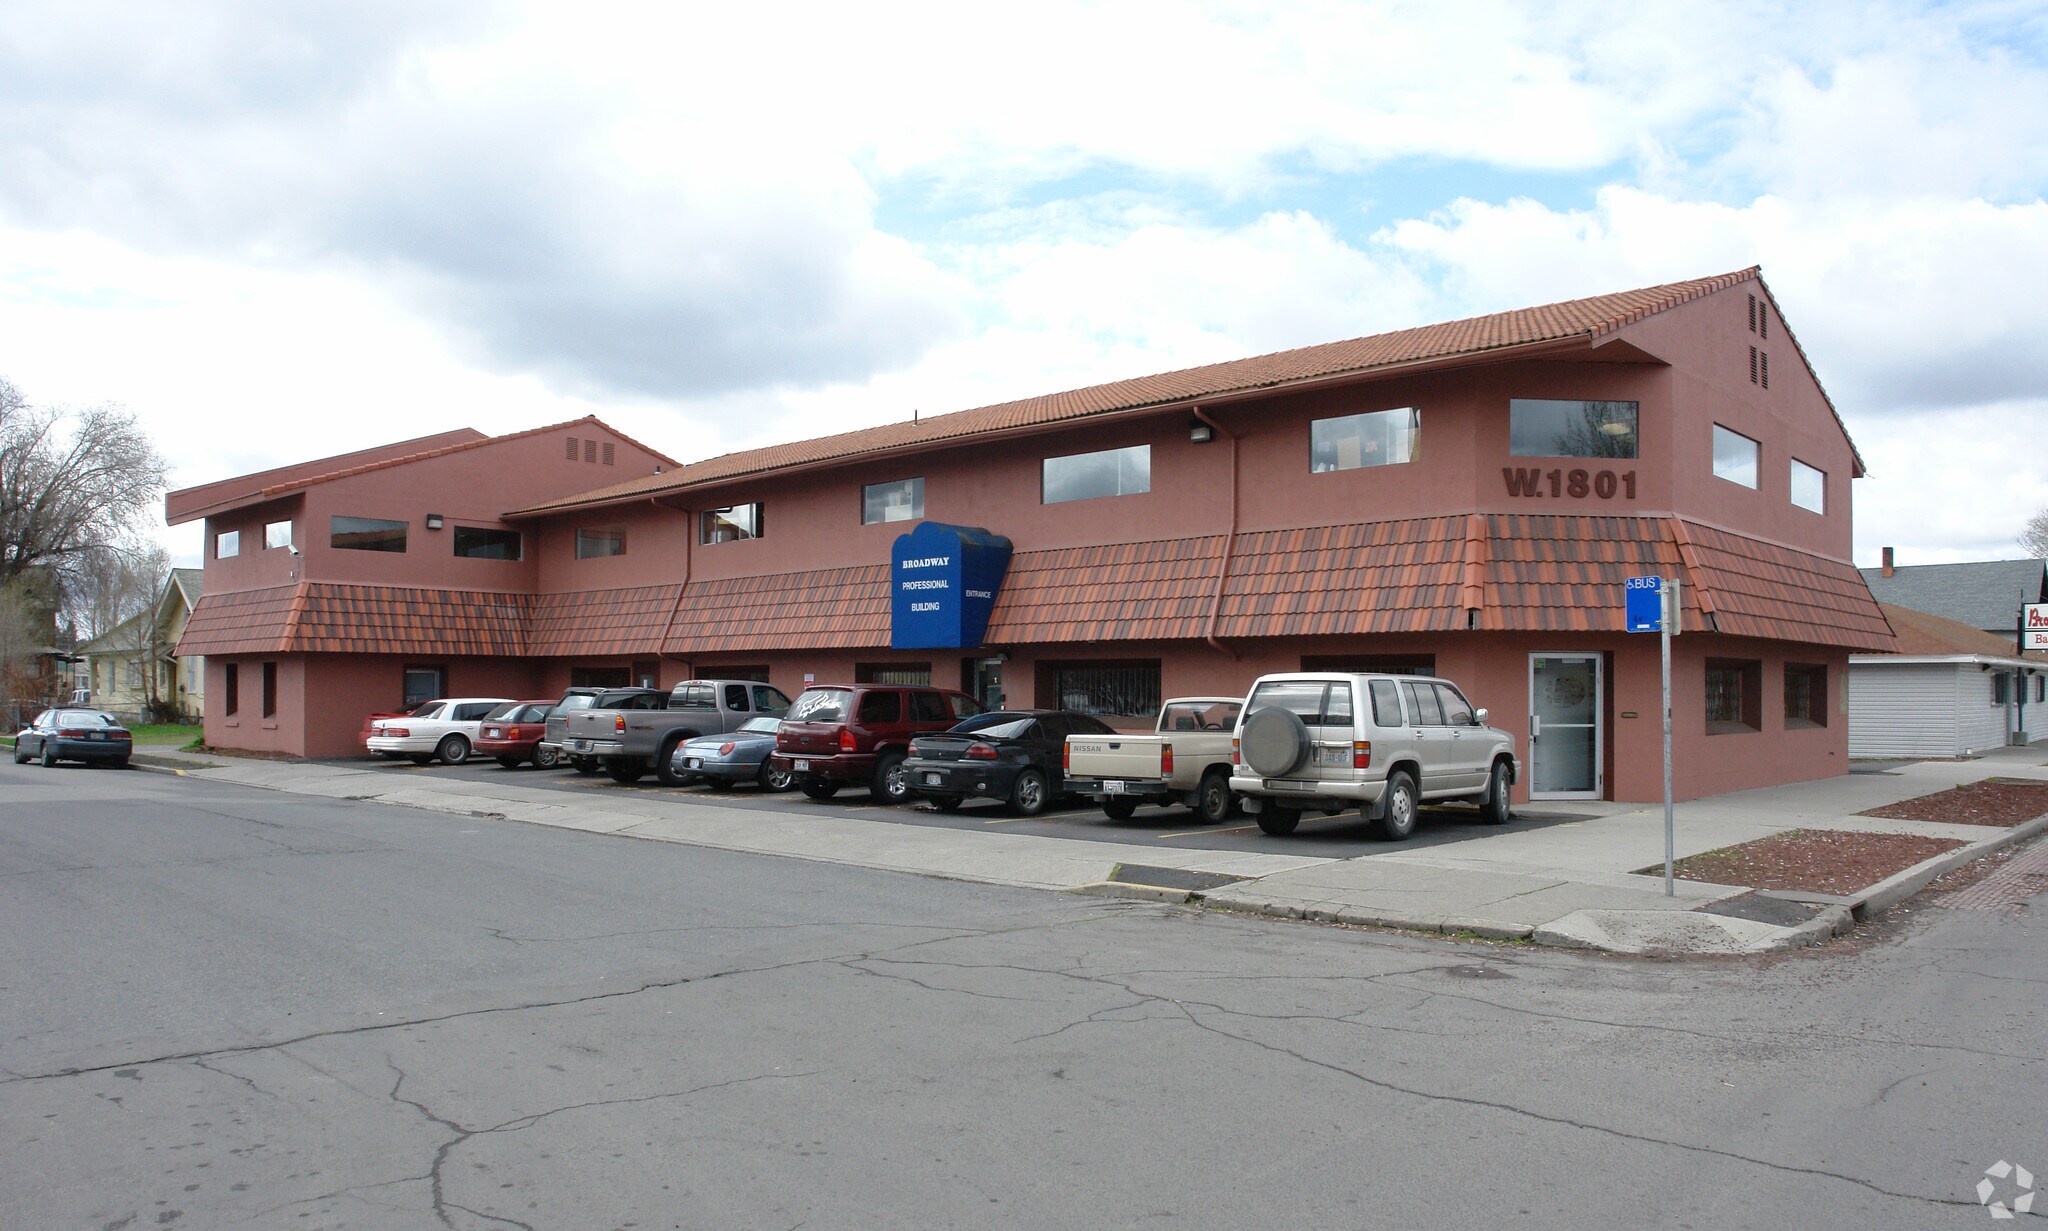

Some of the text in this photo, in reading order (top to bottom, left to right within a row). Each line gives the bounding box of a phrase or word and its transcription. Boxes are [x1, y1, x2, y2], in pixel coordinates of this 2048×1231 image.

[1502, 467, 1636, 499] W.1801
[902, 557, 950, 569] BROADWAY
[902, 580, 949, 590] PROFESSIONAL
[1635, 577, 1655, 588] BUS
[965, 589, 991, 598] ENTRANCE
[911, 602, 940, 611] BUILDING
